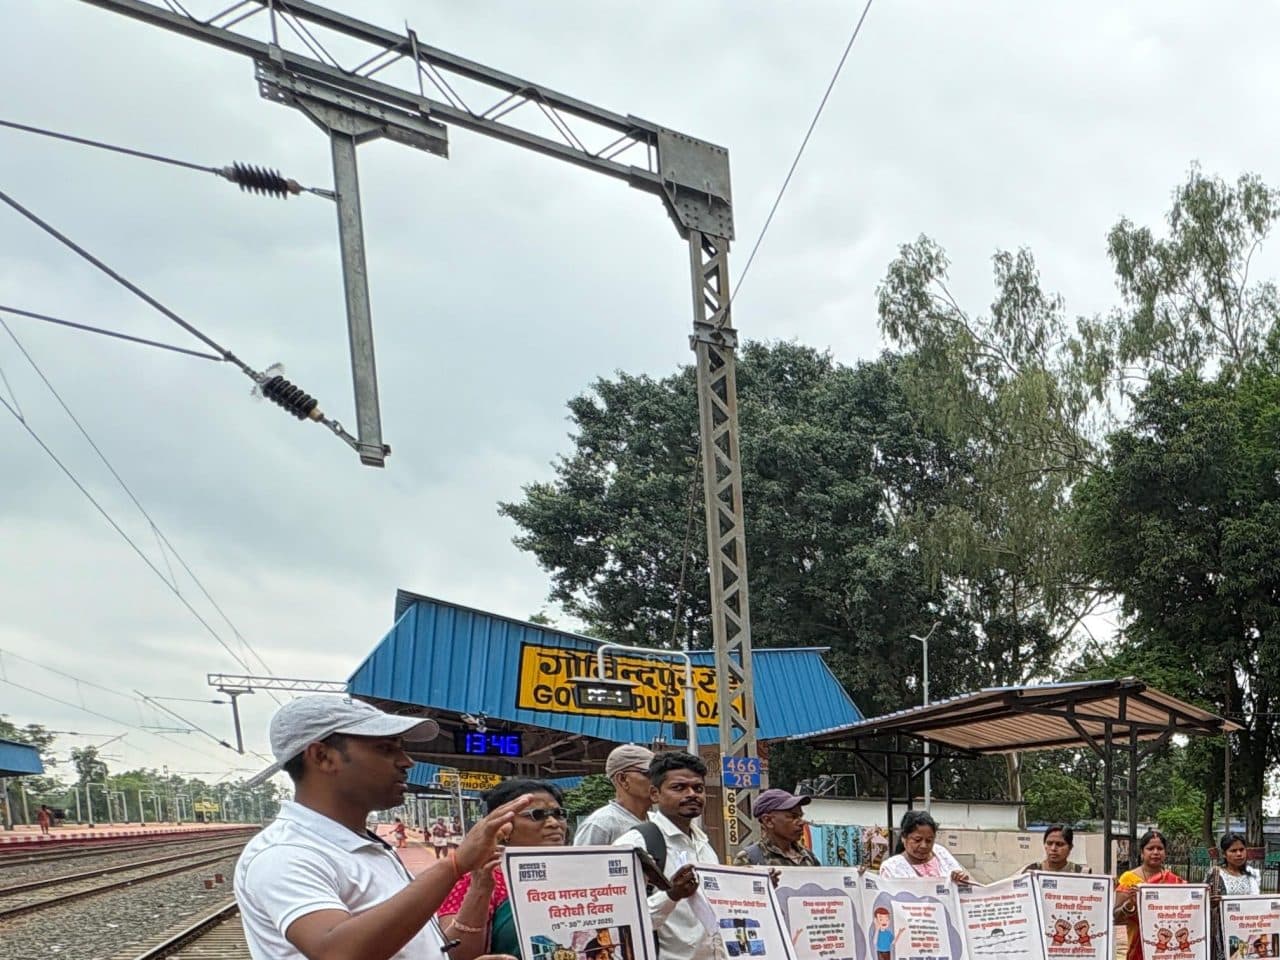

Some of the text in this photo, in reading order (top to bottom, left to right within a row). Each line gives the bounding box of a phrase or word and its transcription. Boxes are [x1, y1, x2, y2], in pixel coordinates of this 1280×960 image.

[466, 734, 519, 755] 13:46
[727, 758, 756, 774] 466
[735, 774, 752, 787] 28
[527, 889, 556, 903] विश्व
[559, 887, 588, 900] मानव
[549, 903, 614, 919] विरोधी दिवस
